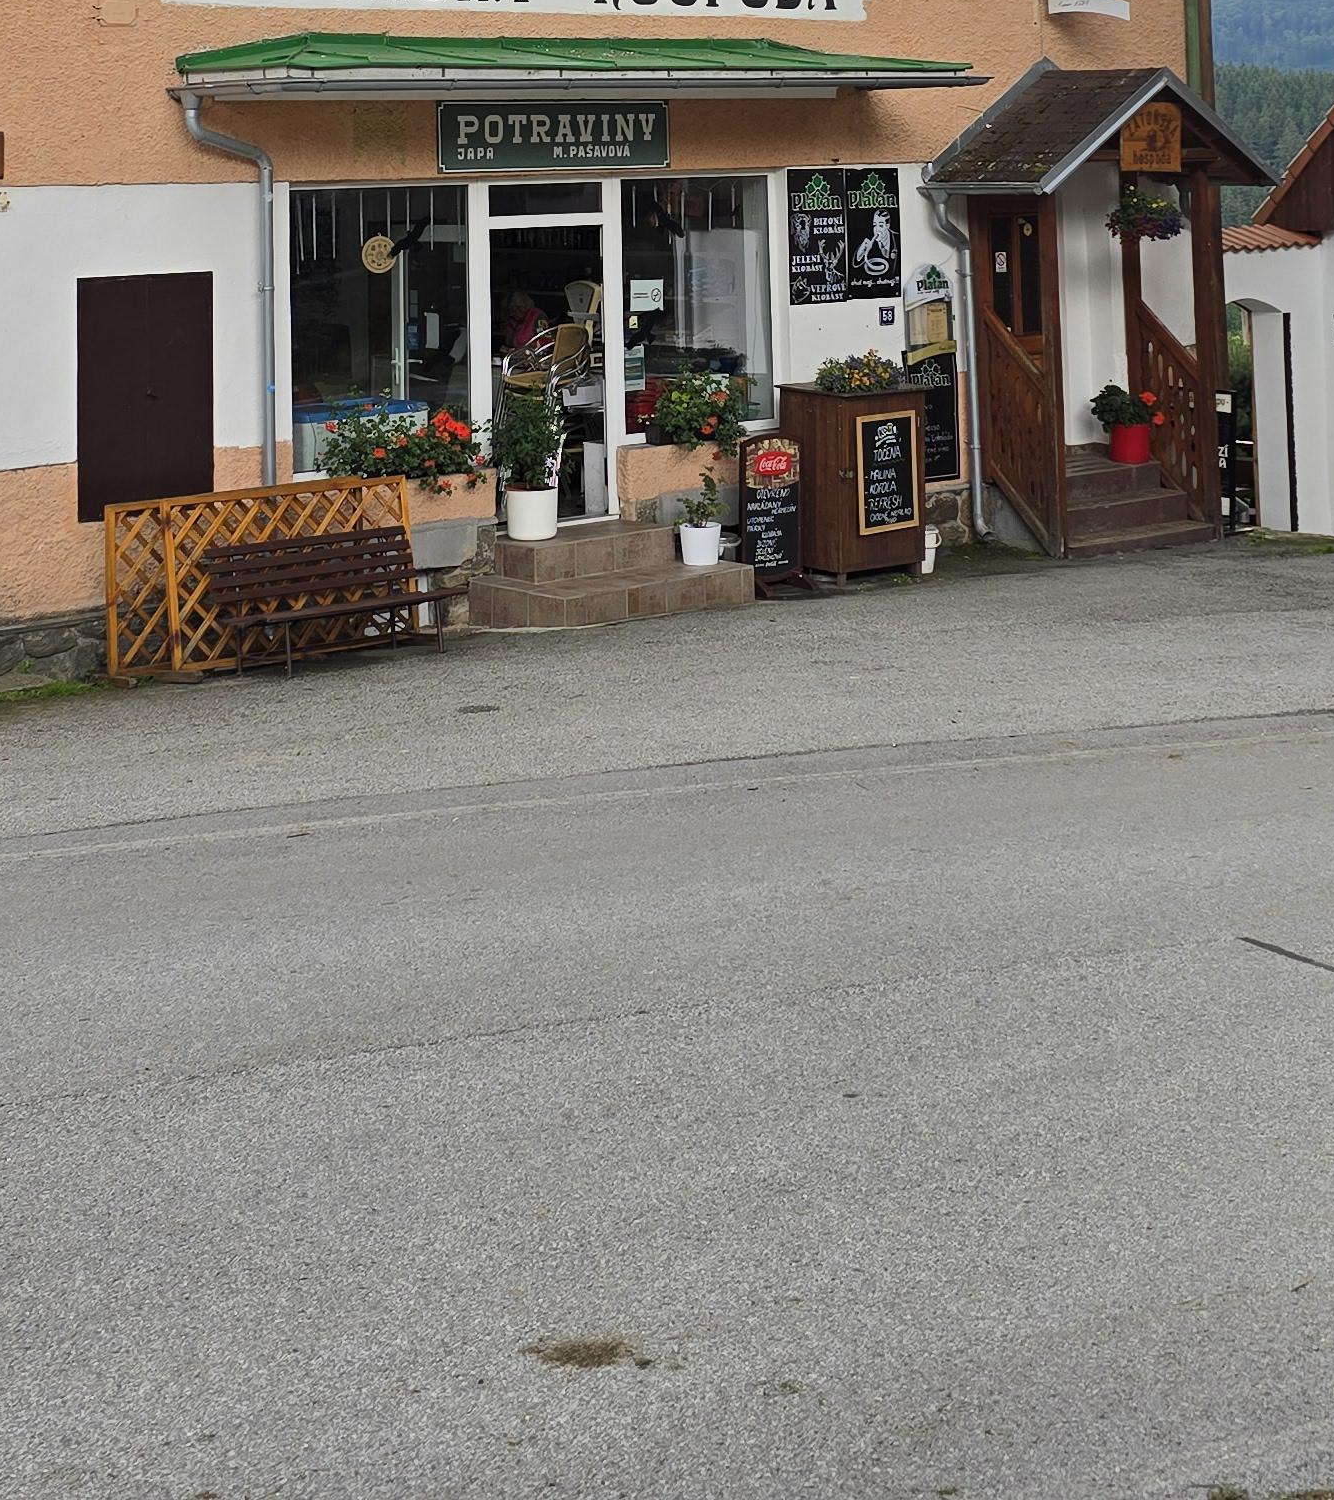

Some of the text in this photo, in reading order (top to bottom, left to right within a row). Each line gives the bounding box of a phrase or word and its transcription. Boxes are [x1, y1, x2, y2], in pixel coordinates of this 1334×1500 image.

[457, 113, 656, 145] POTRAVINY
[457, 147, 495, 160] JAPA
[791, 191, 842, 211] Platan
[847, 190, 898, 209] Platan
[916, 278, 949, 291] Platan
[882, 310, 893, 321] 58
[870, 468, 897, 480] MALINA
[870, 481, 897, 494] KOFOLA
[868, 495, 903, 510] REFRESH
